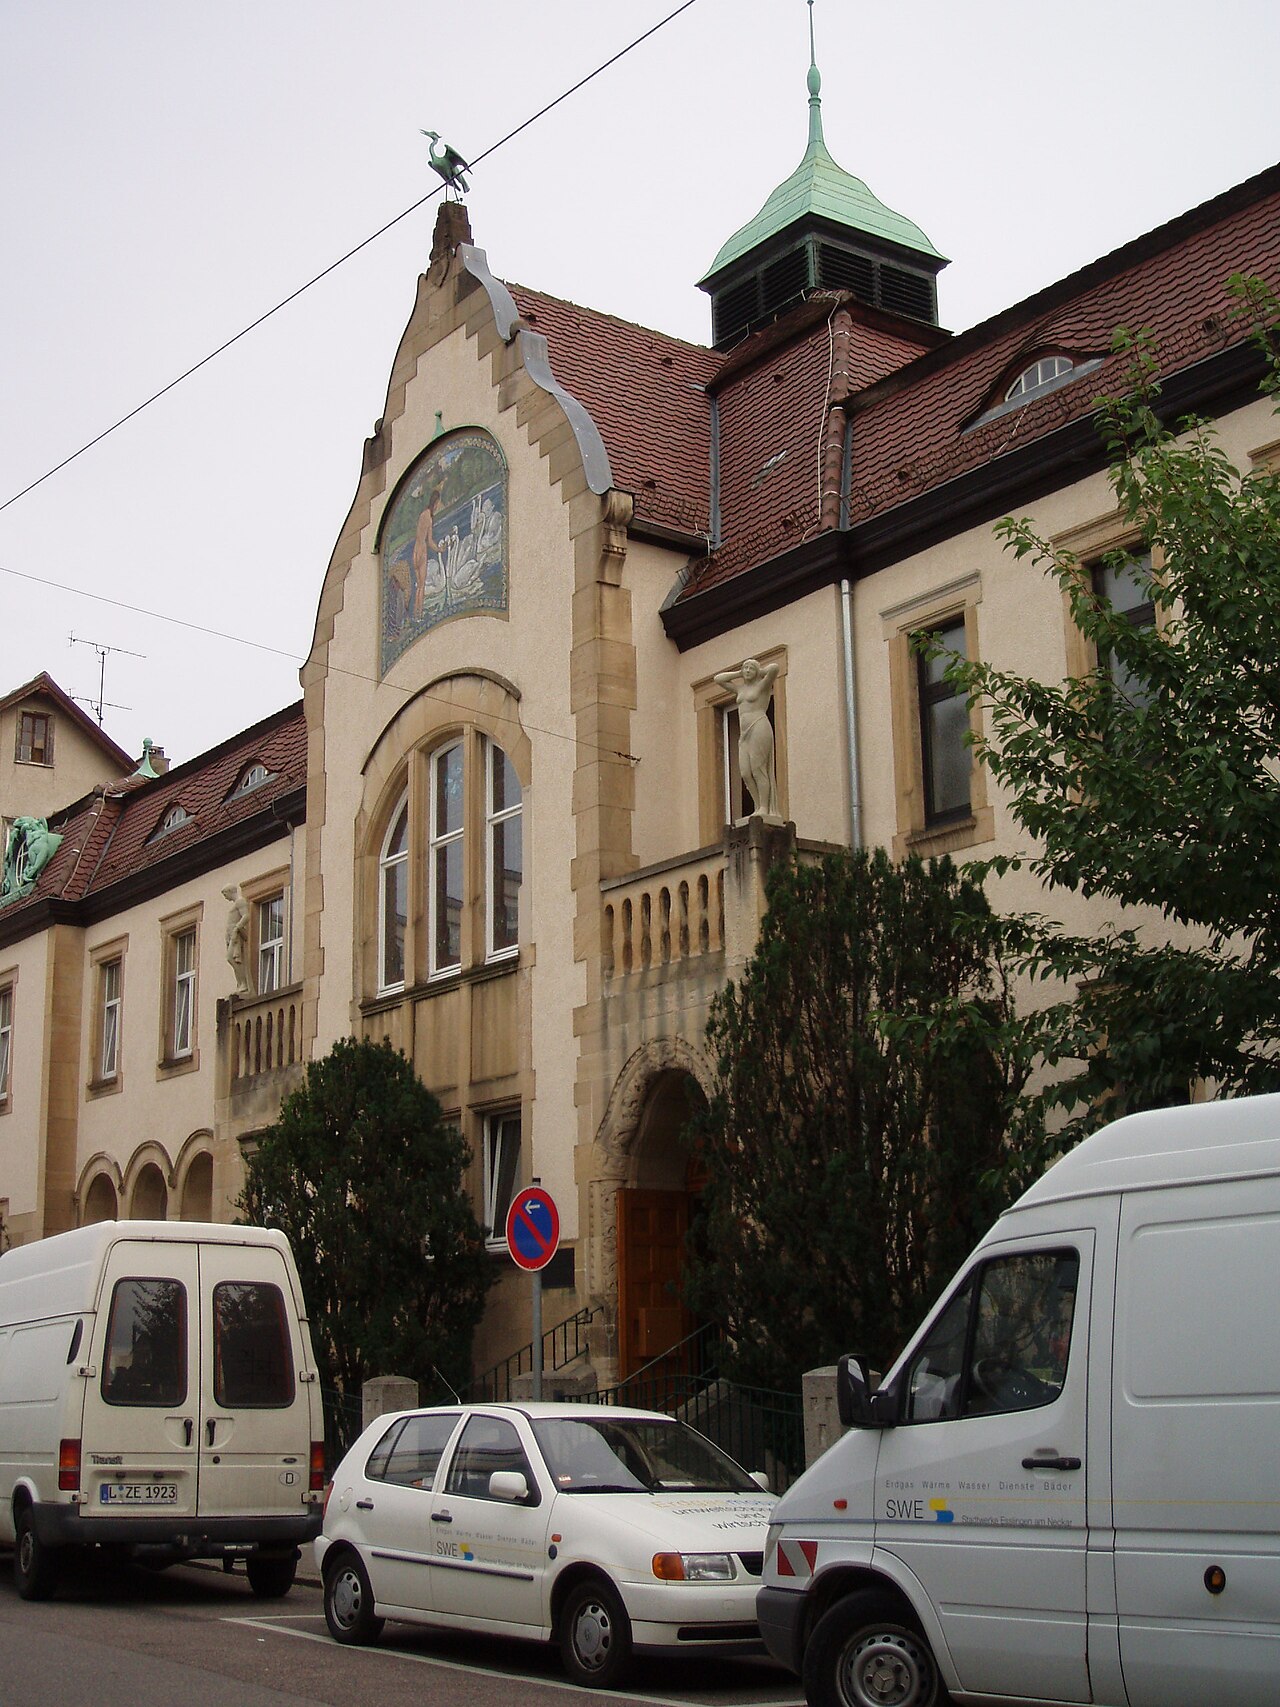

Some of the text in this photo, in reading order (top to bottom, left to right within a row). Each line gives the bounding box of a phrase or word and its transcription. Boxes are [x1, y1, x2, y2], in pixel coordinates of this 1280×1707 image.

[285, 1472, 294, 1485] D
[885, 1480, 914, 1490] Erdgas
[958, 1481, 991, 1490] Wasser
[999, 1481, 1035, 1491] Dienste
[109, 1486, 176, 1499] L ZE 1923
[886, 1499, 924, 1519] SWE
[436, 1541, 458, 1557] SWE
